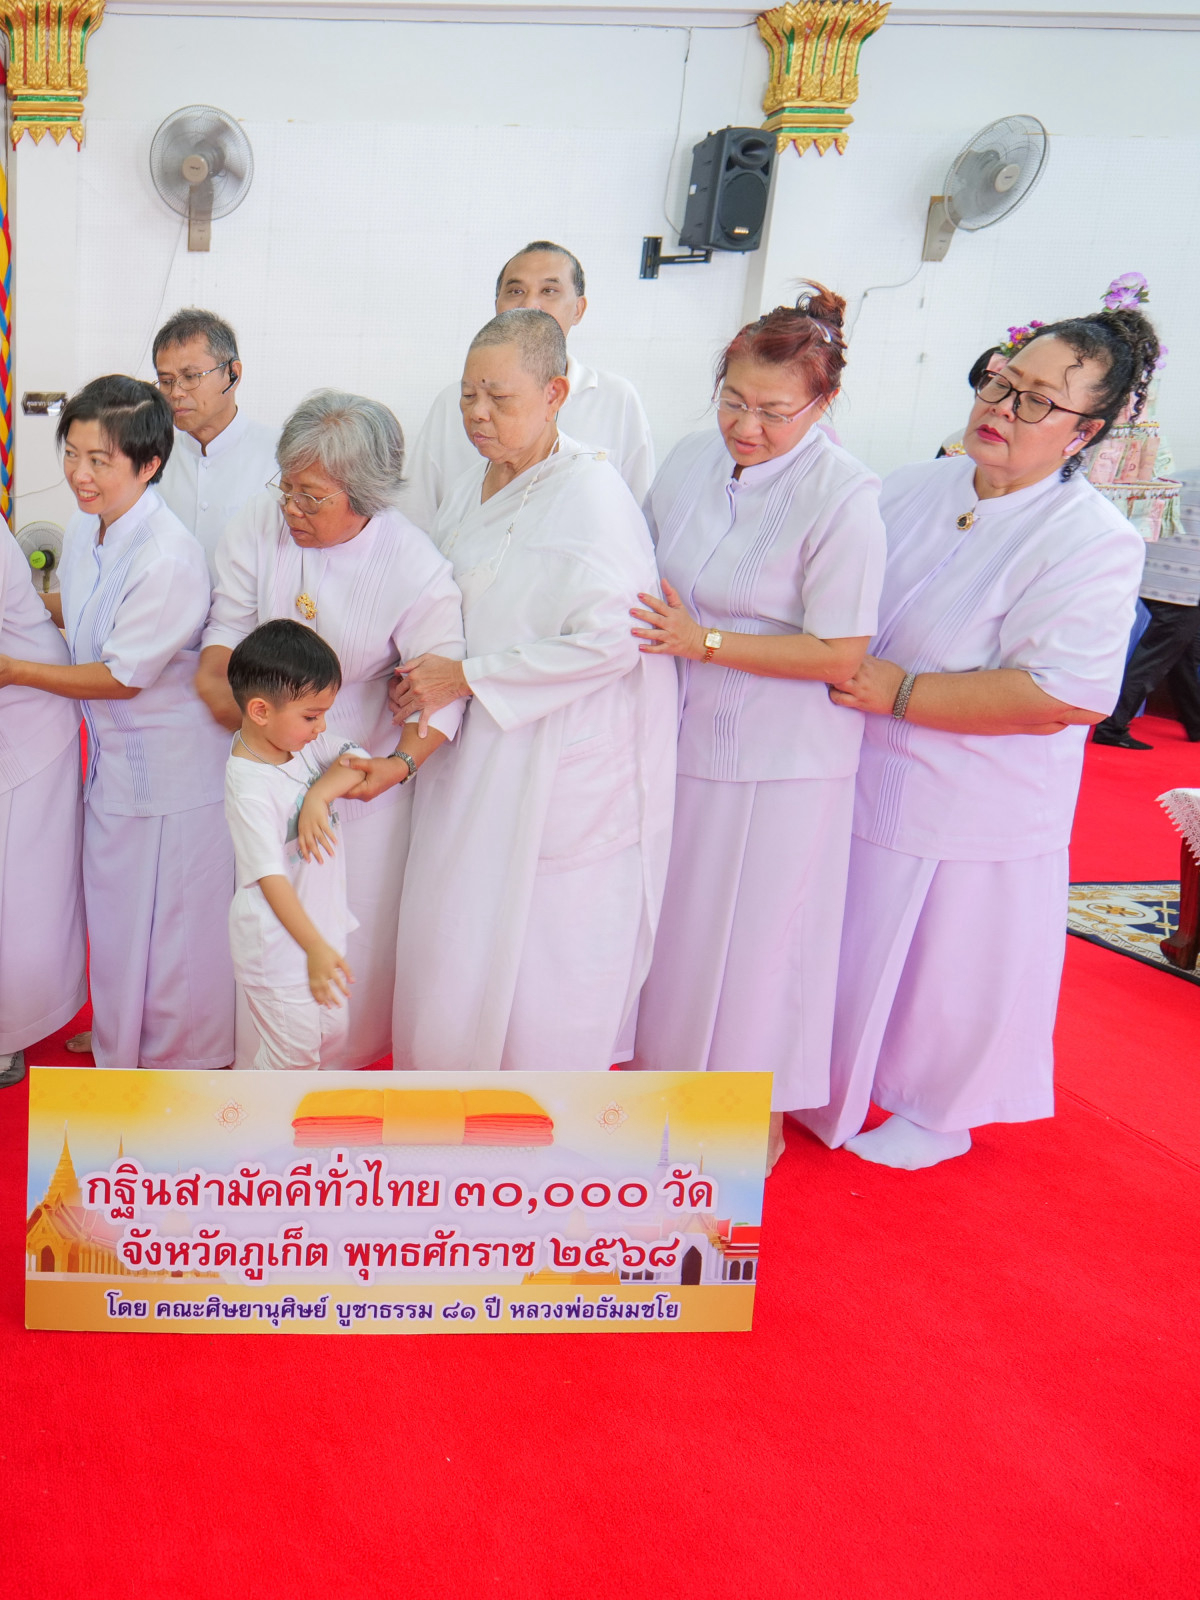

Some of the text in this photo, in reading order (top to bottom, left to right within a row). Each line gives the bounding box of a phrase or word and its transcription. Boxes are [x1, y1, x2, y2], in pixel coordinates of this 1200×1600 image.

[87, 1153, 713, 1219] กฐินสามัคคีทั่วไทย ๓๐,๐๐๐ วัด
[122, 1226, 681, 1281] จังหวัดภูเก็ต พุทธศักราช ๒๕๖๘
[106, 1291, 678, 1327] โดย คณะศิษยานุศิษย์ บูชาธรรม ๘๑ ปี หลวงพ่อธัมมชโย
